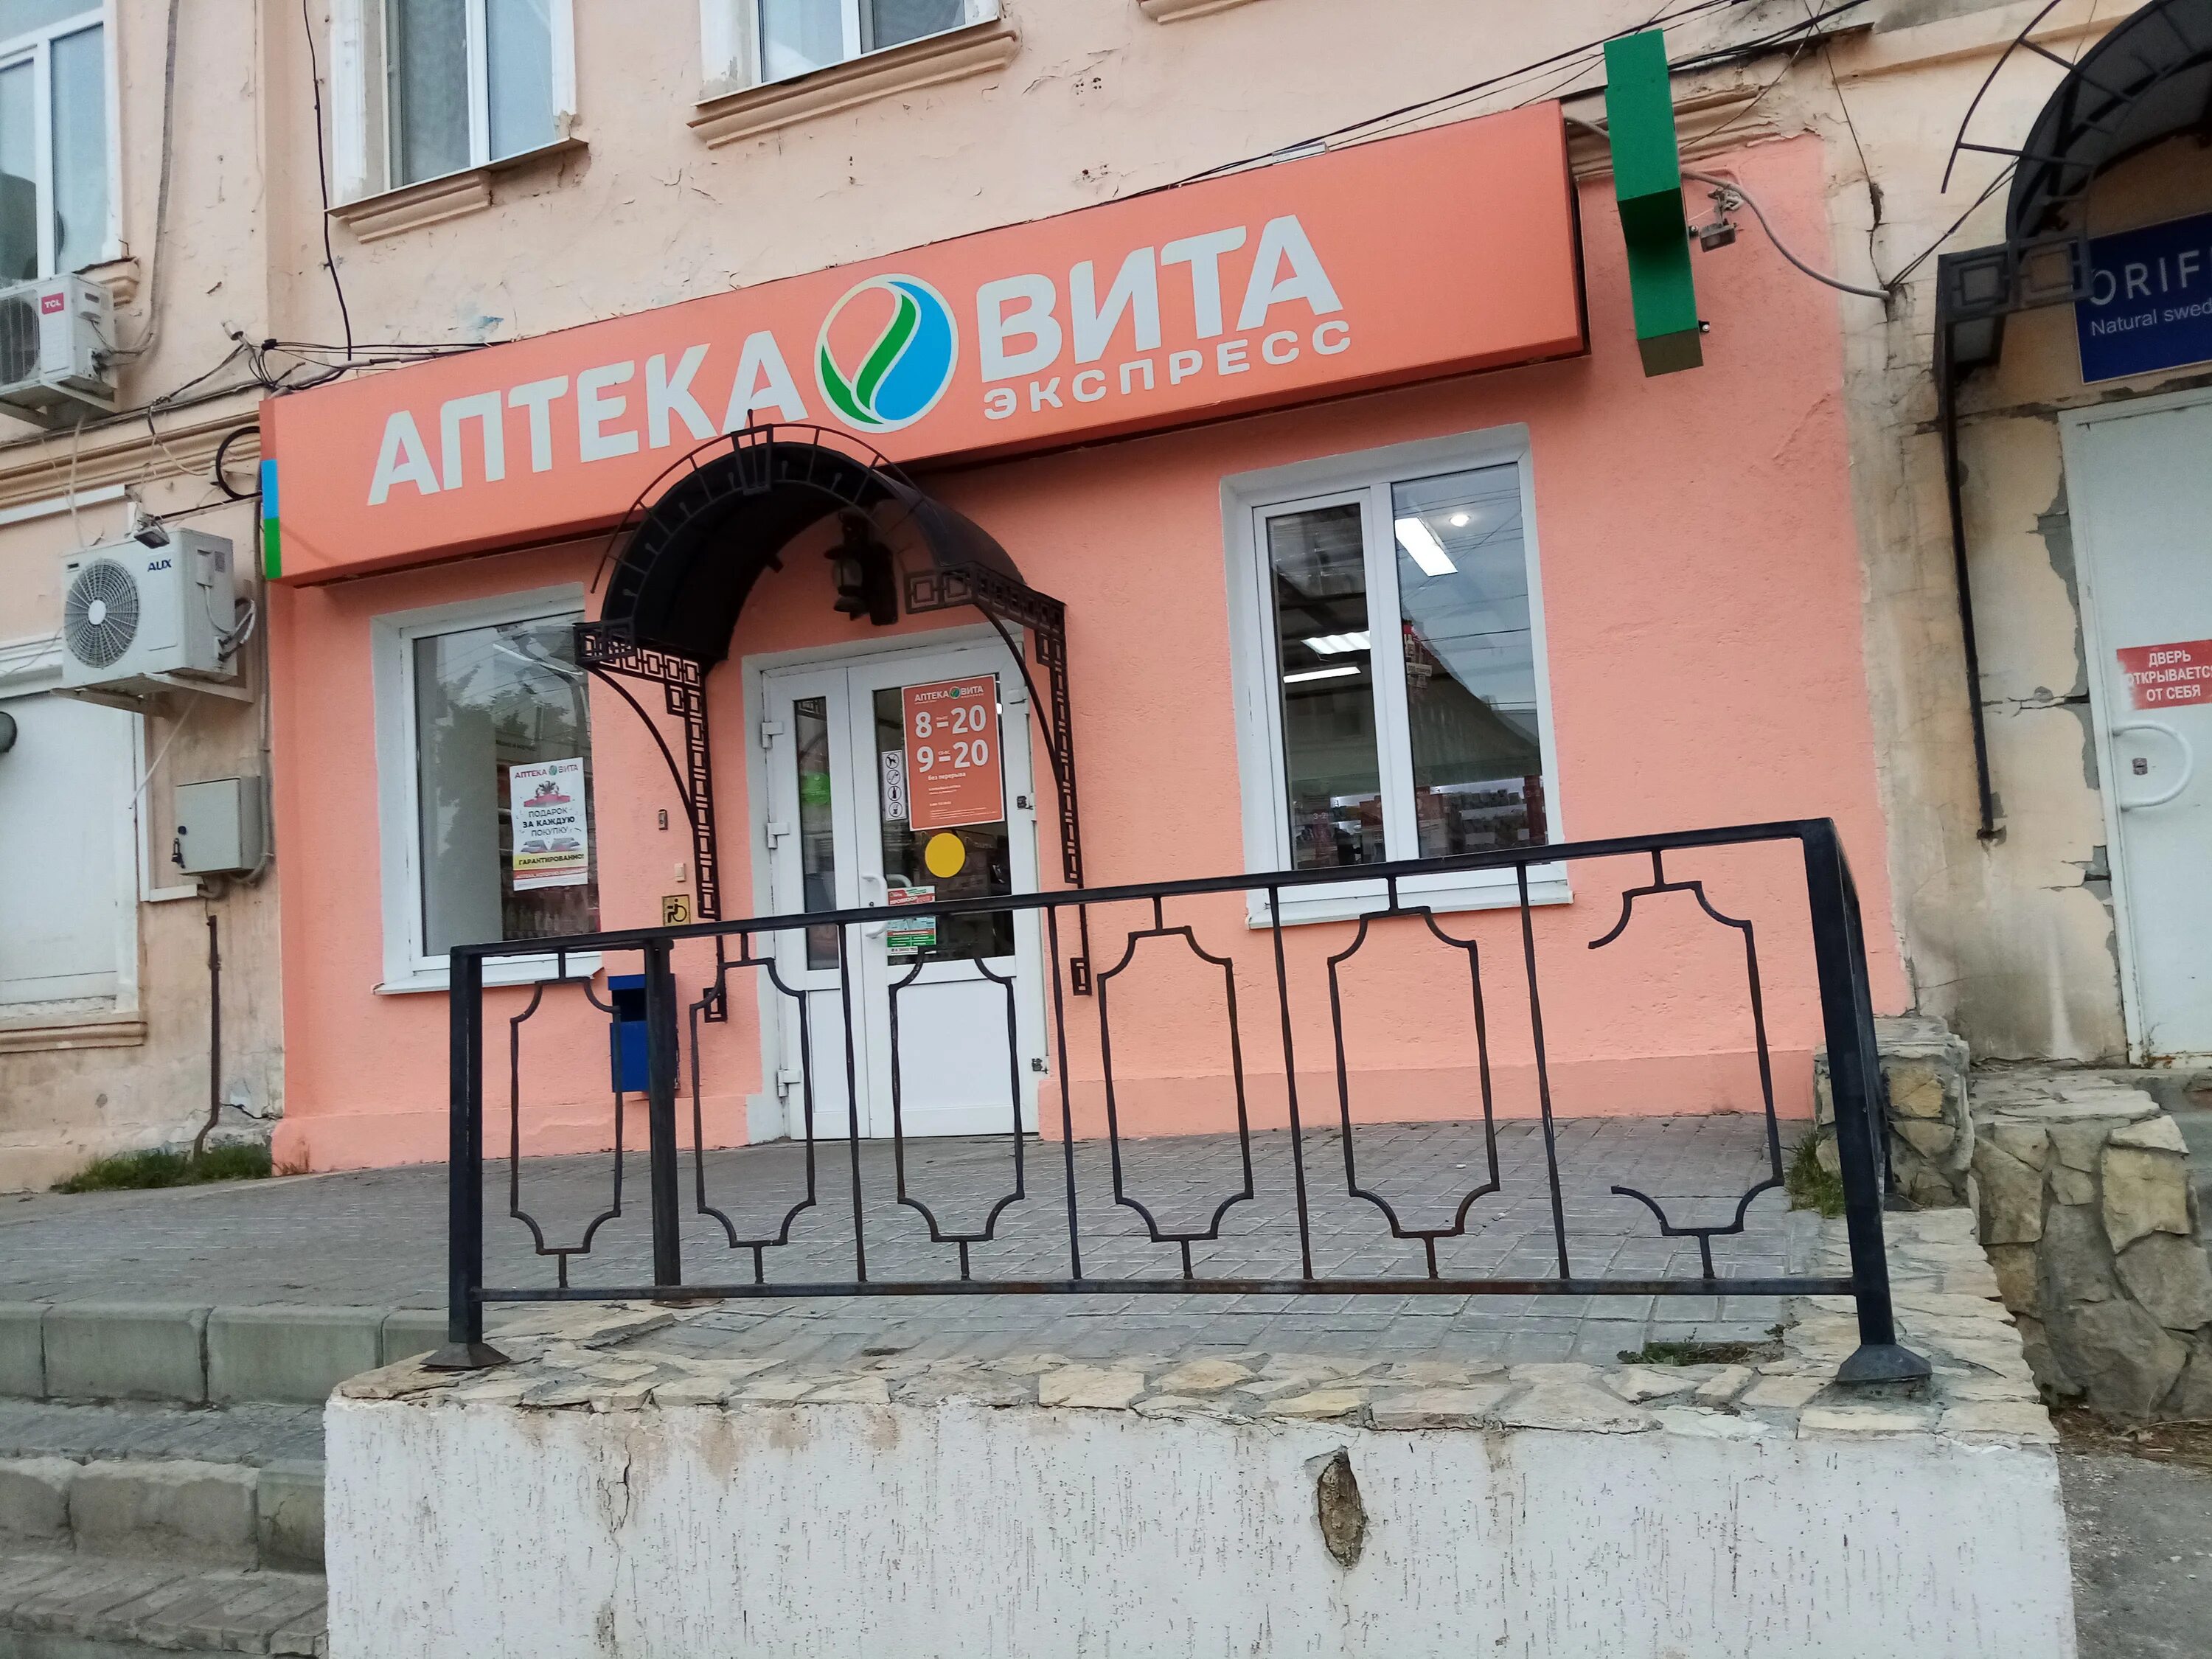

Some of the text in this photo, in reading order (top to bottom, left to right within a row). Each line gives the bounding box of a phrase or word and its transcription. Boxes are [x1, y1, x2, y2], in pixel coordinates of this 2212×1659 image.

[2090, 247, 2212, 306] ORIF
[44, 299, 61, 308] TCL
[2091, 308, 2157, 336] Natural
[366, 214, 1343, 507] АПТЕКА ВИТА
[984, 319, 1352, 420] ЭКСПРЕСС
[147, 559, 172, 572] AUX
[2149, 650, 2191, 668] ДВЕРЬ
[914, 690, 950, 702] АПТЕКА
[961, 685, 984, 695] ВИТА
[2146, 684, 2201, 702] ОТ СЕБЯ
[515, 764, 579, 779] АПТЕКА ВИТА
[529, 807, 568, 818] ПОДАРОК
[536, 816, 575, 827] КАЖДУЮ
[531, 826, 568, 837] ПОКУПКУ
[518, 853, 585, 866] ГАРАНТИРОВАННО!
